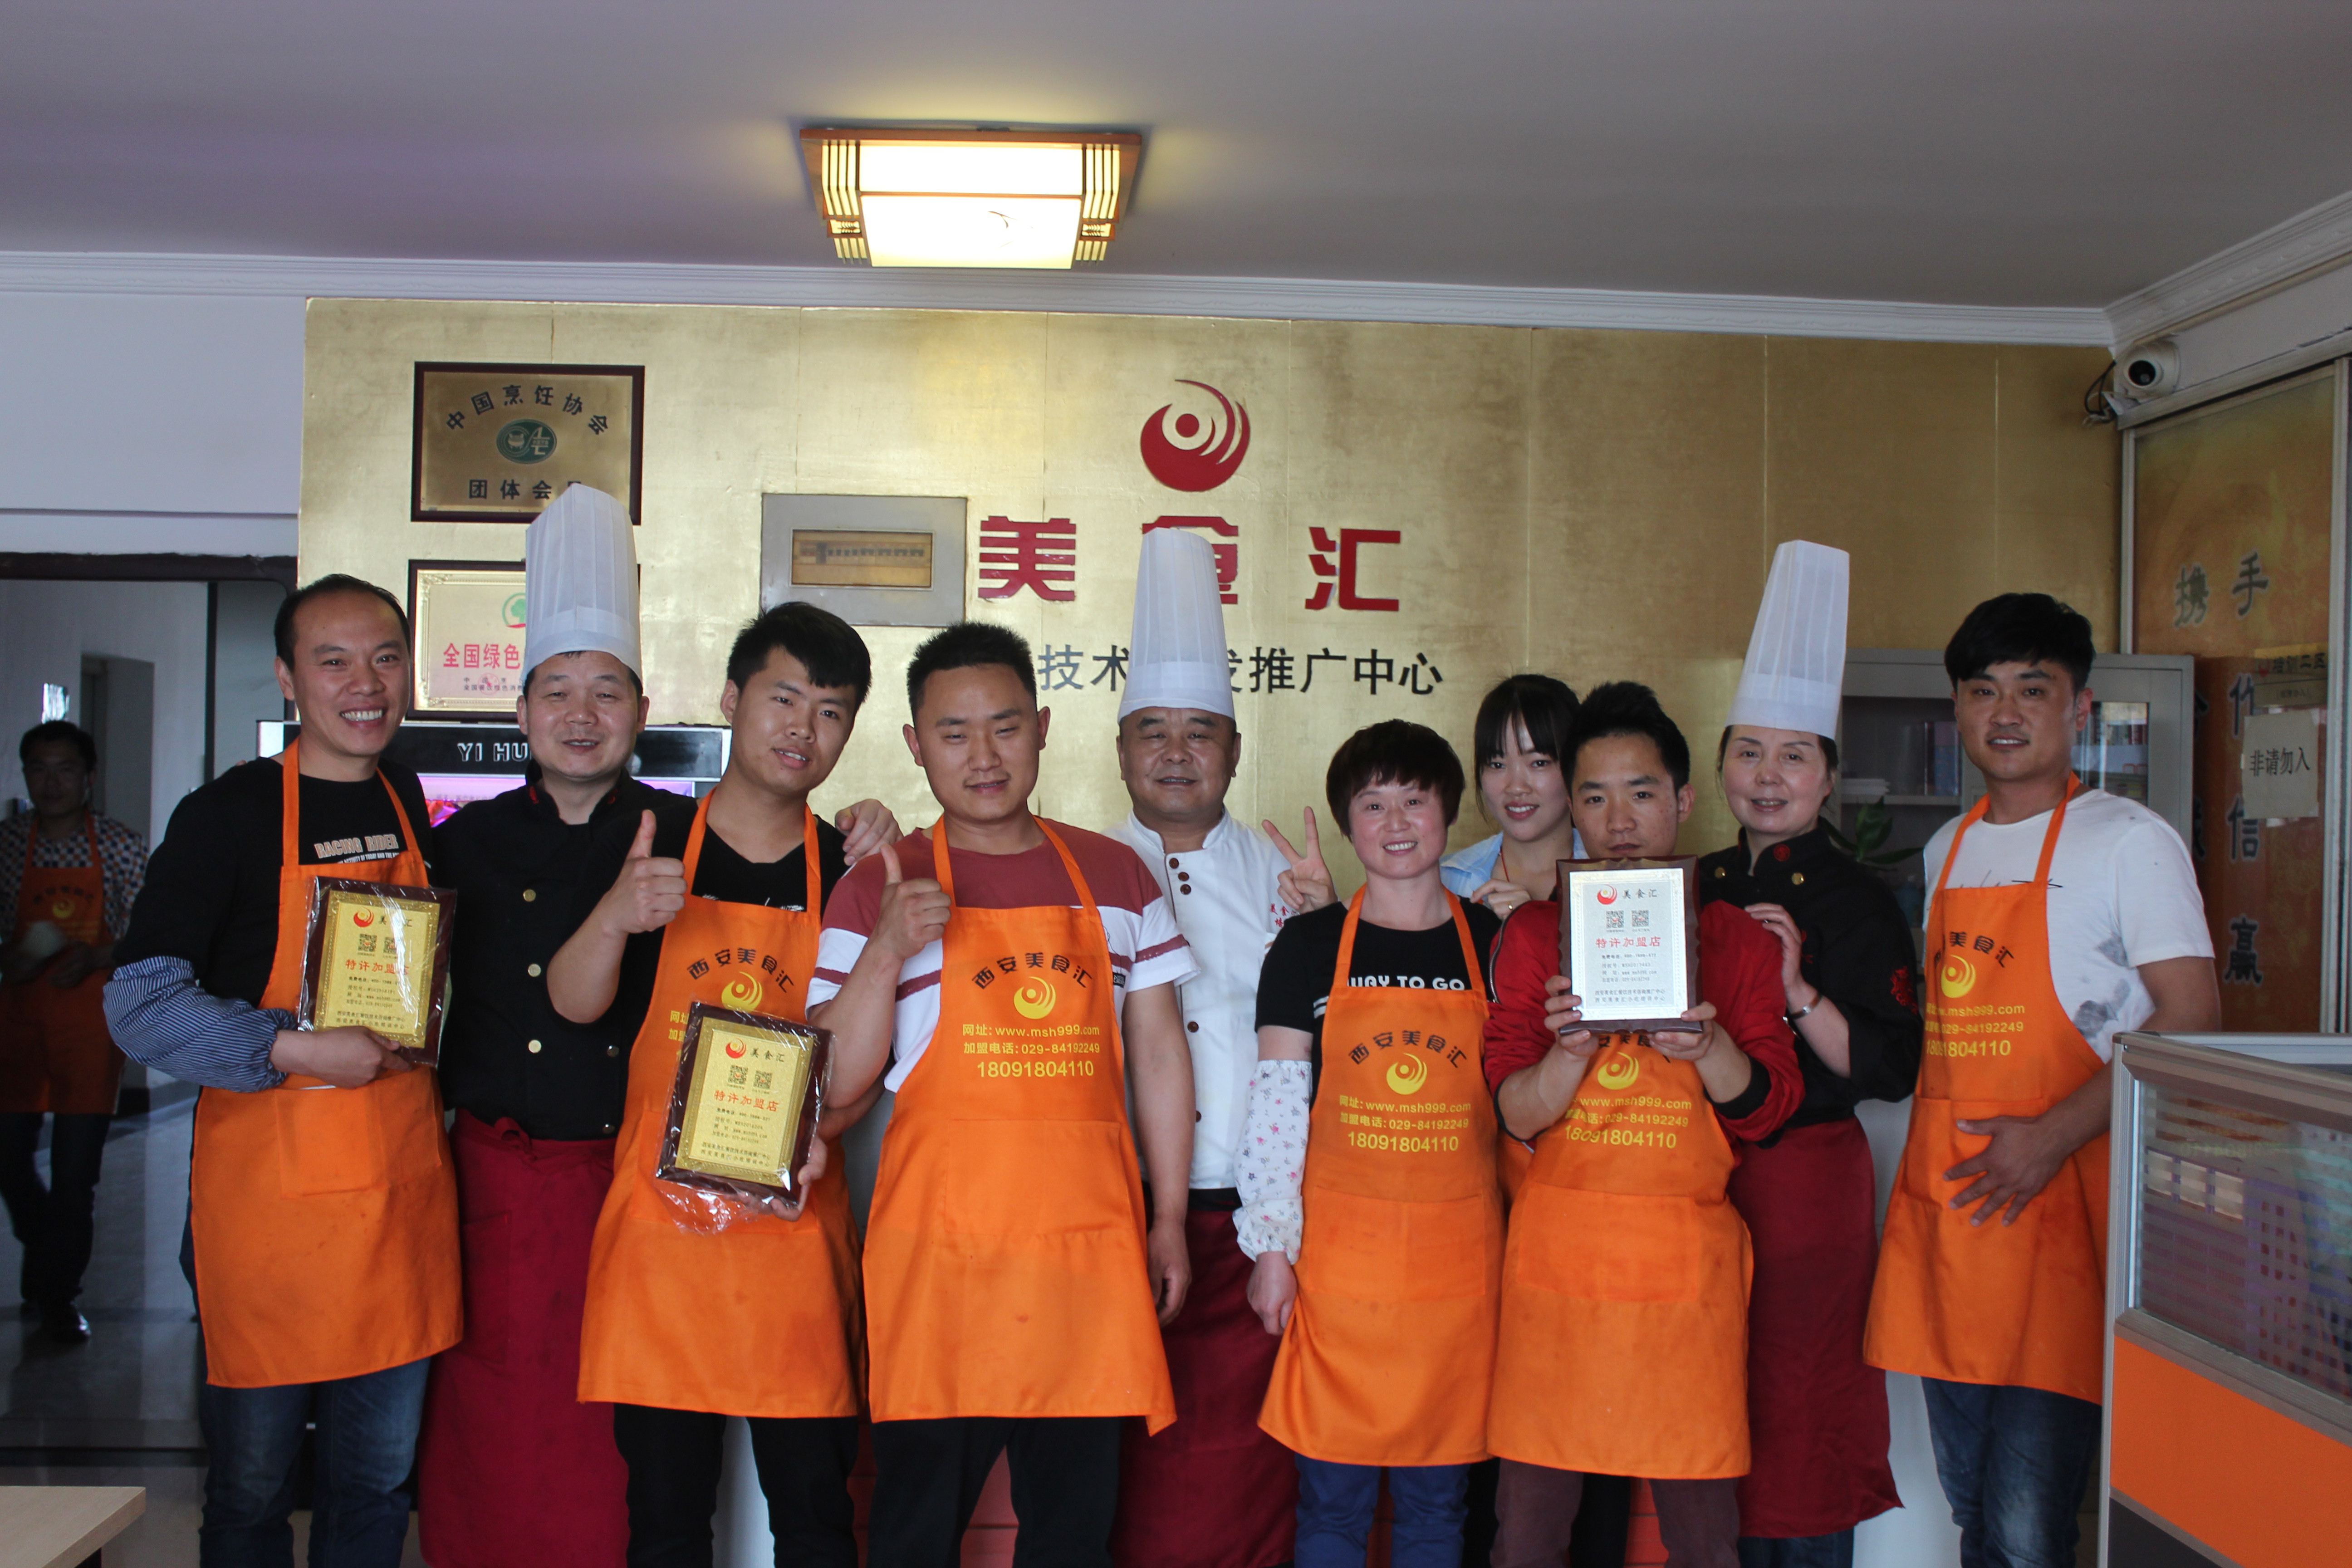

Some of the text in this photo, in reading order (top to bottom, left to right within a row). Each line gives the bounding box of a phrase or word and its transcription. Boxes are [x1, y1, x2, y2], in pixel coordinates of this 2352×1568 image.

[446, 384, 608, 435] 中国烹饪协会
[469, 479, 581, 500] 团体会
[443, 643, 520, 669] 全国绿色
[457, 743, 532, 762] YI HU
[2250, 747, 2310, 776] 非请勿入
[314, 834, 399, 858] RACING RIDER
[1596, 936, 1661, 948] 特许加盟店
[686, 948, 794, 993] 西安美食汇
[972, 952, 1092, 989] 西安美食汇
[1397, 975, 1425, 989] TO
[1432, 977, 1465, 990] GO
[750, 1048, 785, 1062] 美食汇
[1348, 1030, 1466, 1068] 西安美食汇
[977, 1061, 1093, 1078] 18091804110
[715, 1090, 779, 1111] 特许加盟店
[1348, 1132, 1459, 1152] 18091804110
[1565, 1125, 1676, 1148] 18091804110
